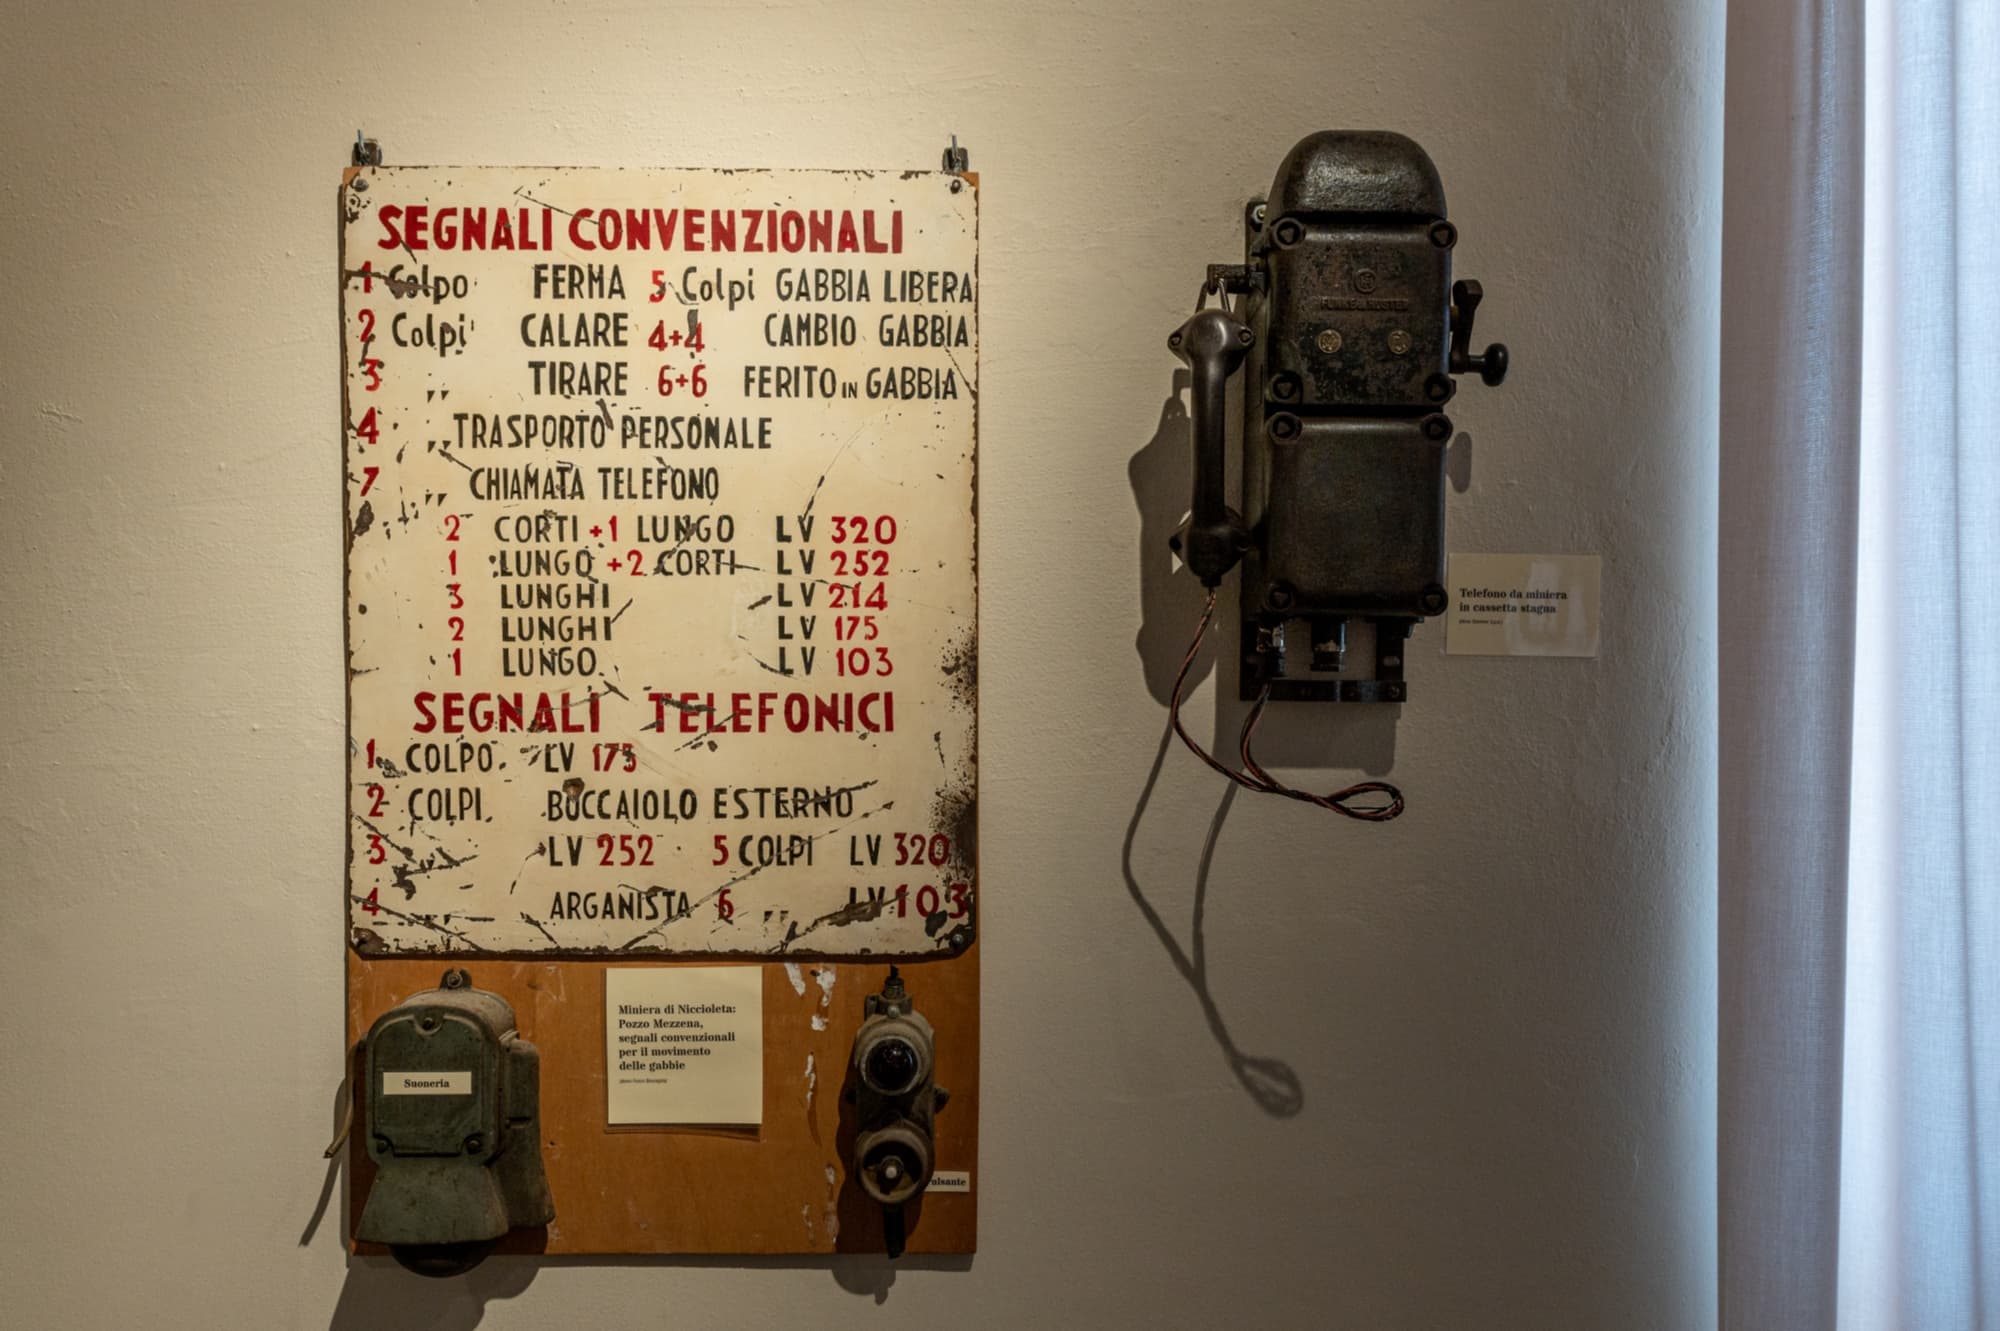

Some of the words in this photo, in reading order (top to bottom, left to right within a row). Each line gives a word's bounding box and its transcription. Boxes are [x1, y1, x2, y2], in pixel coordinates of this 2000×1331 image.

[378, 205, 552, 250] SEGNALI
[568, 207, 903, 254] CONVENZIONALI
[363, 261, 372, 293] 1
[388, 265, 468, 304] Colpo
[534, 264, 626, 300] FERMA
[649, 270, 666, 303] 5
[682, 266, 755, 311] Colpi
[776, 268, 870, 302] GABBIA
[884, 270, 973, 302] LIBERA
[358, 309, 374, 342] 2
[392, 312, 466, 357] Colpi
[520, 313, 628, 347] CALARE
[647, 320, 705, 352] 4+4
[765, 313, 856, 347] CAMBIO
[879, 314, 969, 347] GABBIA
[365, 359, 380, 392] 3
[528, 361, 628, 396] TIRARE
[744, 365, 836, 399] FERITO
[842, 382, 858, 399] IN
[866, 367, 958, 400] GABBIA
[356, 407, 379, 444] 4
[453, 413, 606, 449] TRASPORTO
[621, 415, 772, 449] PERSONALE
[360, 467, 379, 496] 7
[469, 467, 585, 500] CHIAMATA
[598, 467, 719, 500] TELEFONO
[444, 515, 460, 541] 2
[494, 515, 578, 542] CORTI
[637, 515, 734, 543] LUNGO
[776, 515, 814, 543] LV
[830, 515, 897, 545] 320
[449, 550, 457, 576] 1
[499, 550, 593, 577] LUNGO
[657, 549, 735, 576] CORTI
[777, 549, 815, 576] LV
[830, 551, 889, 577] 252
[450, 583, 464, 609] 3
[500, 583, 610, 609] LUNGHI
[777, 582, 815, 607] LV
[828, 581, 888, 610] 214
[1459, 588, 1507, 599] Telefono
[1509, 589, 1523, 599] da
[1526, 589, 1568, 600] miniera
[1459, 602, 1470, 612] in
[1473, 602, 1517, 613] cassetta
[1520, 603, 1557, 615] stagna
[448, 616, 464, 641] 2
[501, 616, 612, 642] LUNGHI
[777, 615, 816, 640] LV
[834, 616, 879, 641] 175
[452, 648, 461, 676] 1
[502, 647, 596, 677] LUNGO
[779, 646, 816, 675] LV
[836, 647, 894, 677] 103
[413, 692, 600, 733] SEGNALI
[648, 691, 894, 733] TELEFONICI
[366, 739, 375, 769] 1
[406, 743, 493, 773] COLPO
[545, 742, 575, 773] LV
[367, 785, 384, 817] 2
[408, 787, 482, 821] COLPI
[548, 788, 697, 822] BOCCAIOLO
[714, 787, 853, 820] ESTERNO
[368, 834, 385, 865] 3
[548, 835, 583, 867] LV
[597, 833, 654, 866] 252
[712, 835, 729, 866] 5
[738, 835, 813, 867] COLPI
[850, 834, 881, 866] LV
[894, 832, 950, 867] 320
[362, 887, 379, 916] 4
[550, 891, 691, 921] ARGANISTA
[718, 889, 734, 919] 6
[895, 884, 968, 919] 103
[618, 1004, 661, 1015] Miniera
[664, 1004, 675, 1014] di
[678, 1003, 736, 1014] Niccioleta:
[618, 1019, 650, 1029] Pozzo
[653, 1018, 704, 1030] Mezzena,
[618, 1033, 658, 1045] segnali
[660, 1032, 736, 1043] convenzionali
[619, 1048, 637, 1059] per
[640, 1047, 648, 1057] il
[651, 1047, 711, 1057] movimento
[619, 1061, 646, 1071] delle
[649, 1060, 686, 1072] gabbie
[404, 1078, 450, 1088] Suoneria
[931, 1177, 967, 1186] ulsante
